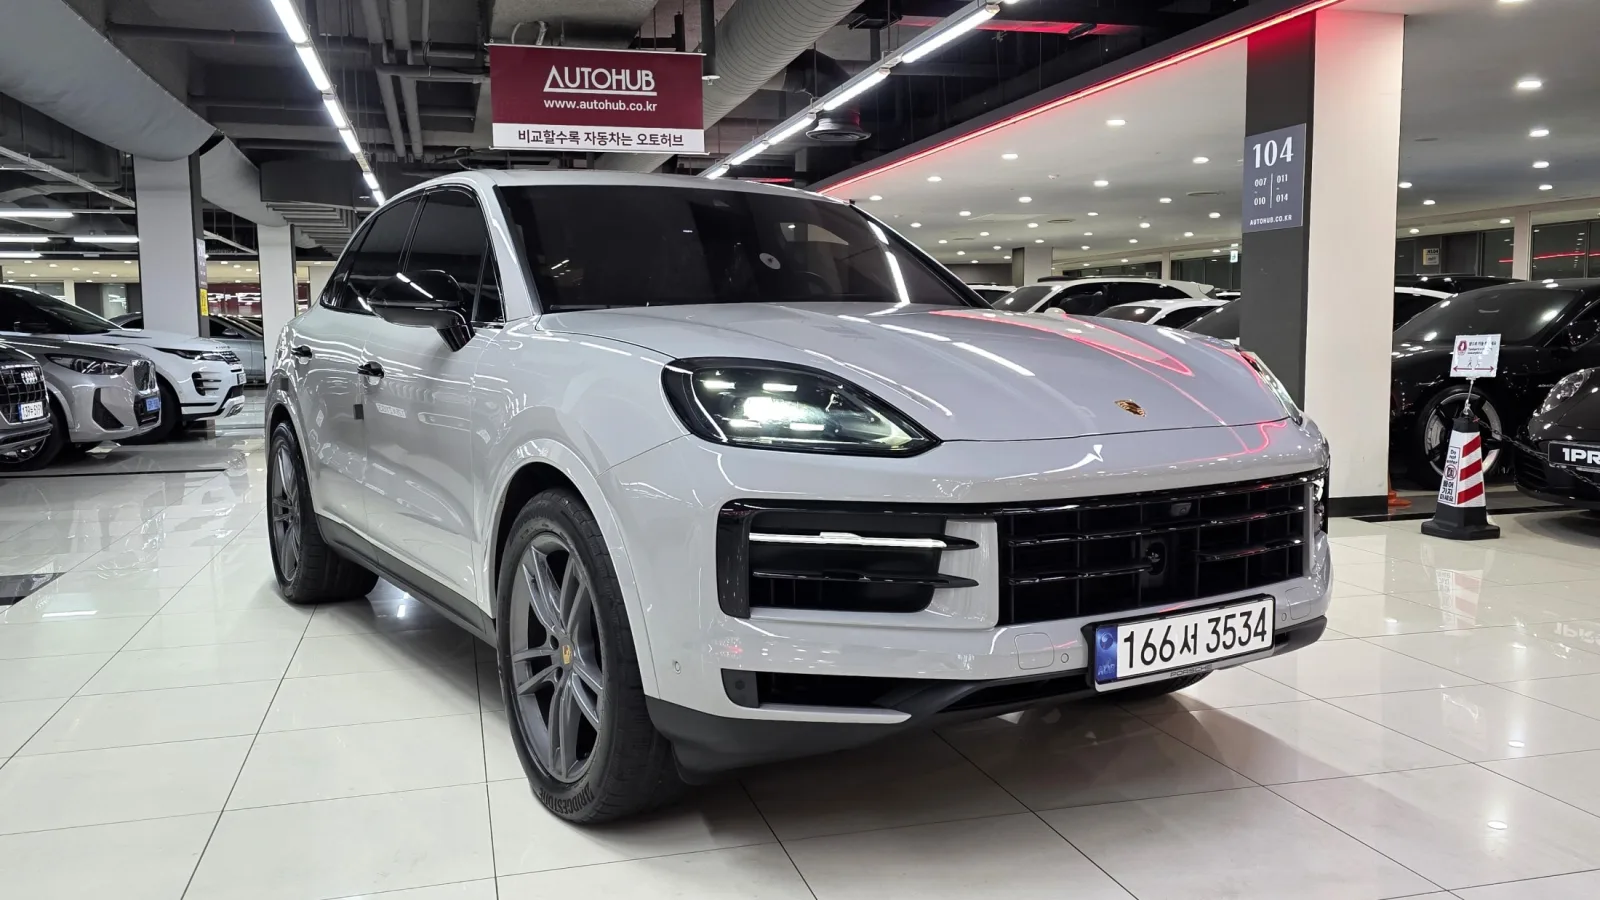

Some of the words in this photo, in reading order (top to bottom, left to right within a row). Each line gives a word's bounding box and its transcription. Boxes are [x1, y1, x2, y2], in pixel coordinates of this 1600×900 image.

[543, 65, 656, 93] AUTOHUB
[543, 99, 658, 112] www.autohub.co.kr
[518, 129, 581, 146] 비교할수록
[584, 132, 633, 147] 자동차는
[636, 133, 684, 148] 오토허브
[1253, 136, 1294, 169] 104
[1254, 177, 1267, 187] 007
[1276, 173, 1288, 184] 011
[1253, 196, 1266, 206] 010
[1275, 193, 1289, 203] 014
[1249, 214, 1293, 226] AUTOHUB.CO.KR
[1123, 623, 1198, 669] 166서
[1205, 606, 1267, 654] 3534
